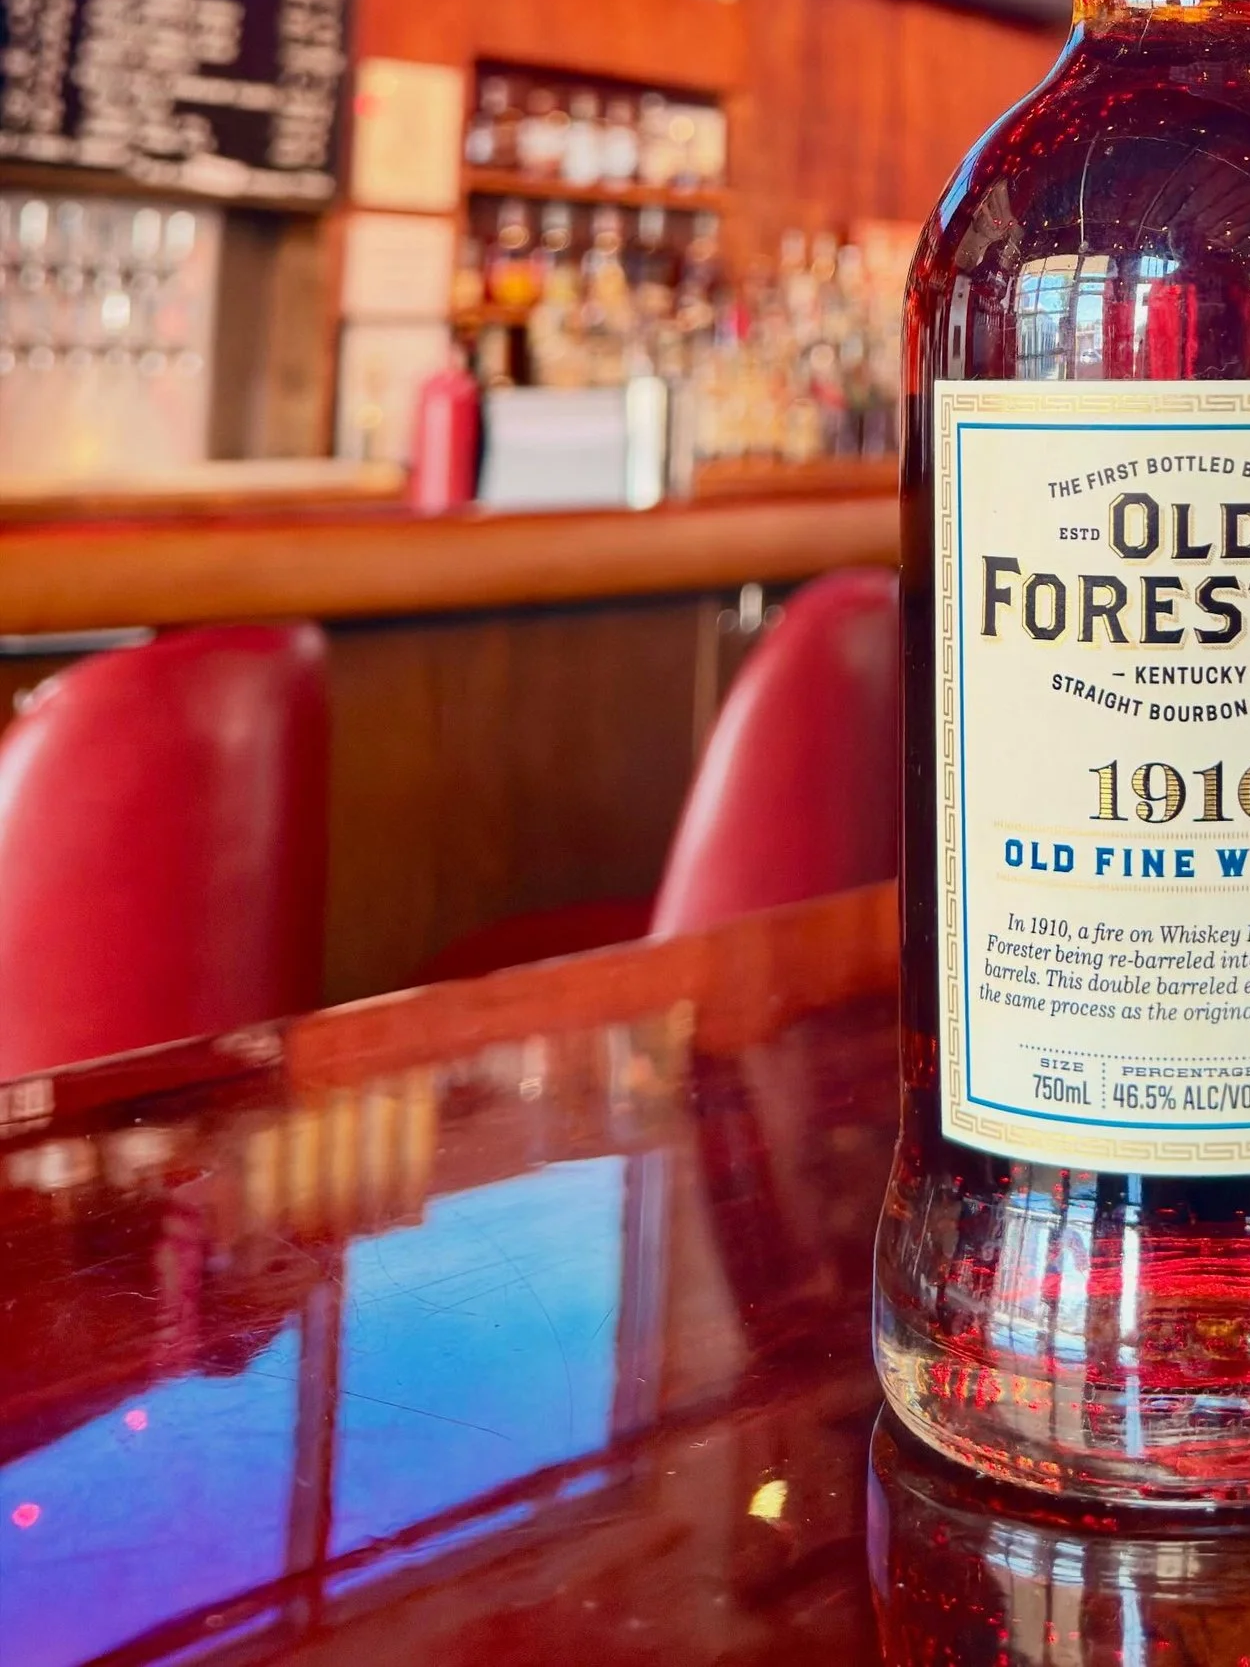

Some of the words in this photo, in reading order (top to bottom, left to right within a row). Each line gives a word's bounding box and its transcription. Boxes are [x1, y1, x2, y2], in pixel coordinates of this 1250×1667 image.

[1048, 478, 1083, 498] THE
[1086, 460, 1139, 491] FIRST
[1146, 455, 1235, 475] BOTTLED
[1059, 527, 1100, 541] ESTD
[1135, 666, 1247, 684] KENTUCKY
[1051, 673, 1143, 717] STRAIGHT
[1149, 699, 1248, 722] BOURBON
[1004, 838, 1075, 873] OLD
[1095, 846, 1196, 878] FINE
[1007, 913, 1025, 932] In
[1030, 917, 1072, 942] 1910,
[1078, 925, 1089, 939] a
[1092, 922, 1124, 943] fire
[1129, 928, 1154, 942] on
[1160, 924, 1241, 946] Whiskey
[986, 934, 1052, 961] Forester
[1055, 944, 1104, 969] being
[1108, 950, 1216, 969] re-barreled
[984, 958, 1041, 985] barrels.
[1045, 968, 1083, 990] This
[1087, 973, 1151, 995] double
[1156, 976, 1238, 995] barreled
[979, 983, 1001, 1003] the
[1004, 991, 1046, 1011] same
[1050, 998, 1116, 1017] process
[1121, 1005, 1142, 1020] as
[1147, 1002, 1177, 1021] the
[1040, 1057, 1084, 1072] SIZE
[1032, 1074, 1092, 1105] 750mL
[1113, 1082, 1177, 1110] 46.5%
